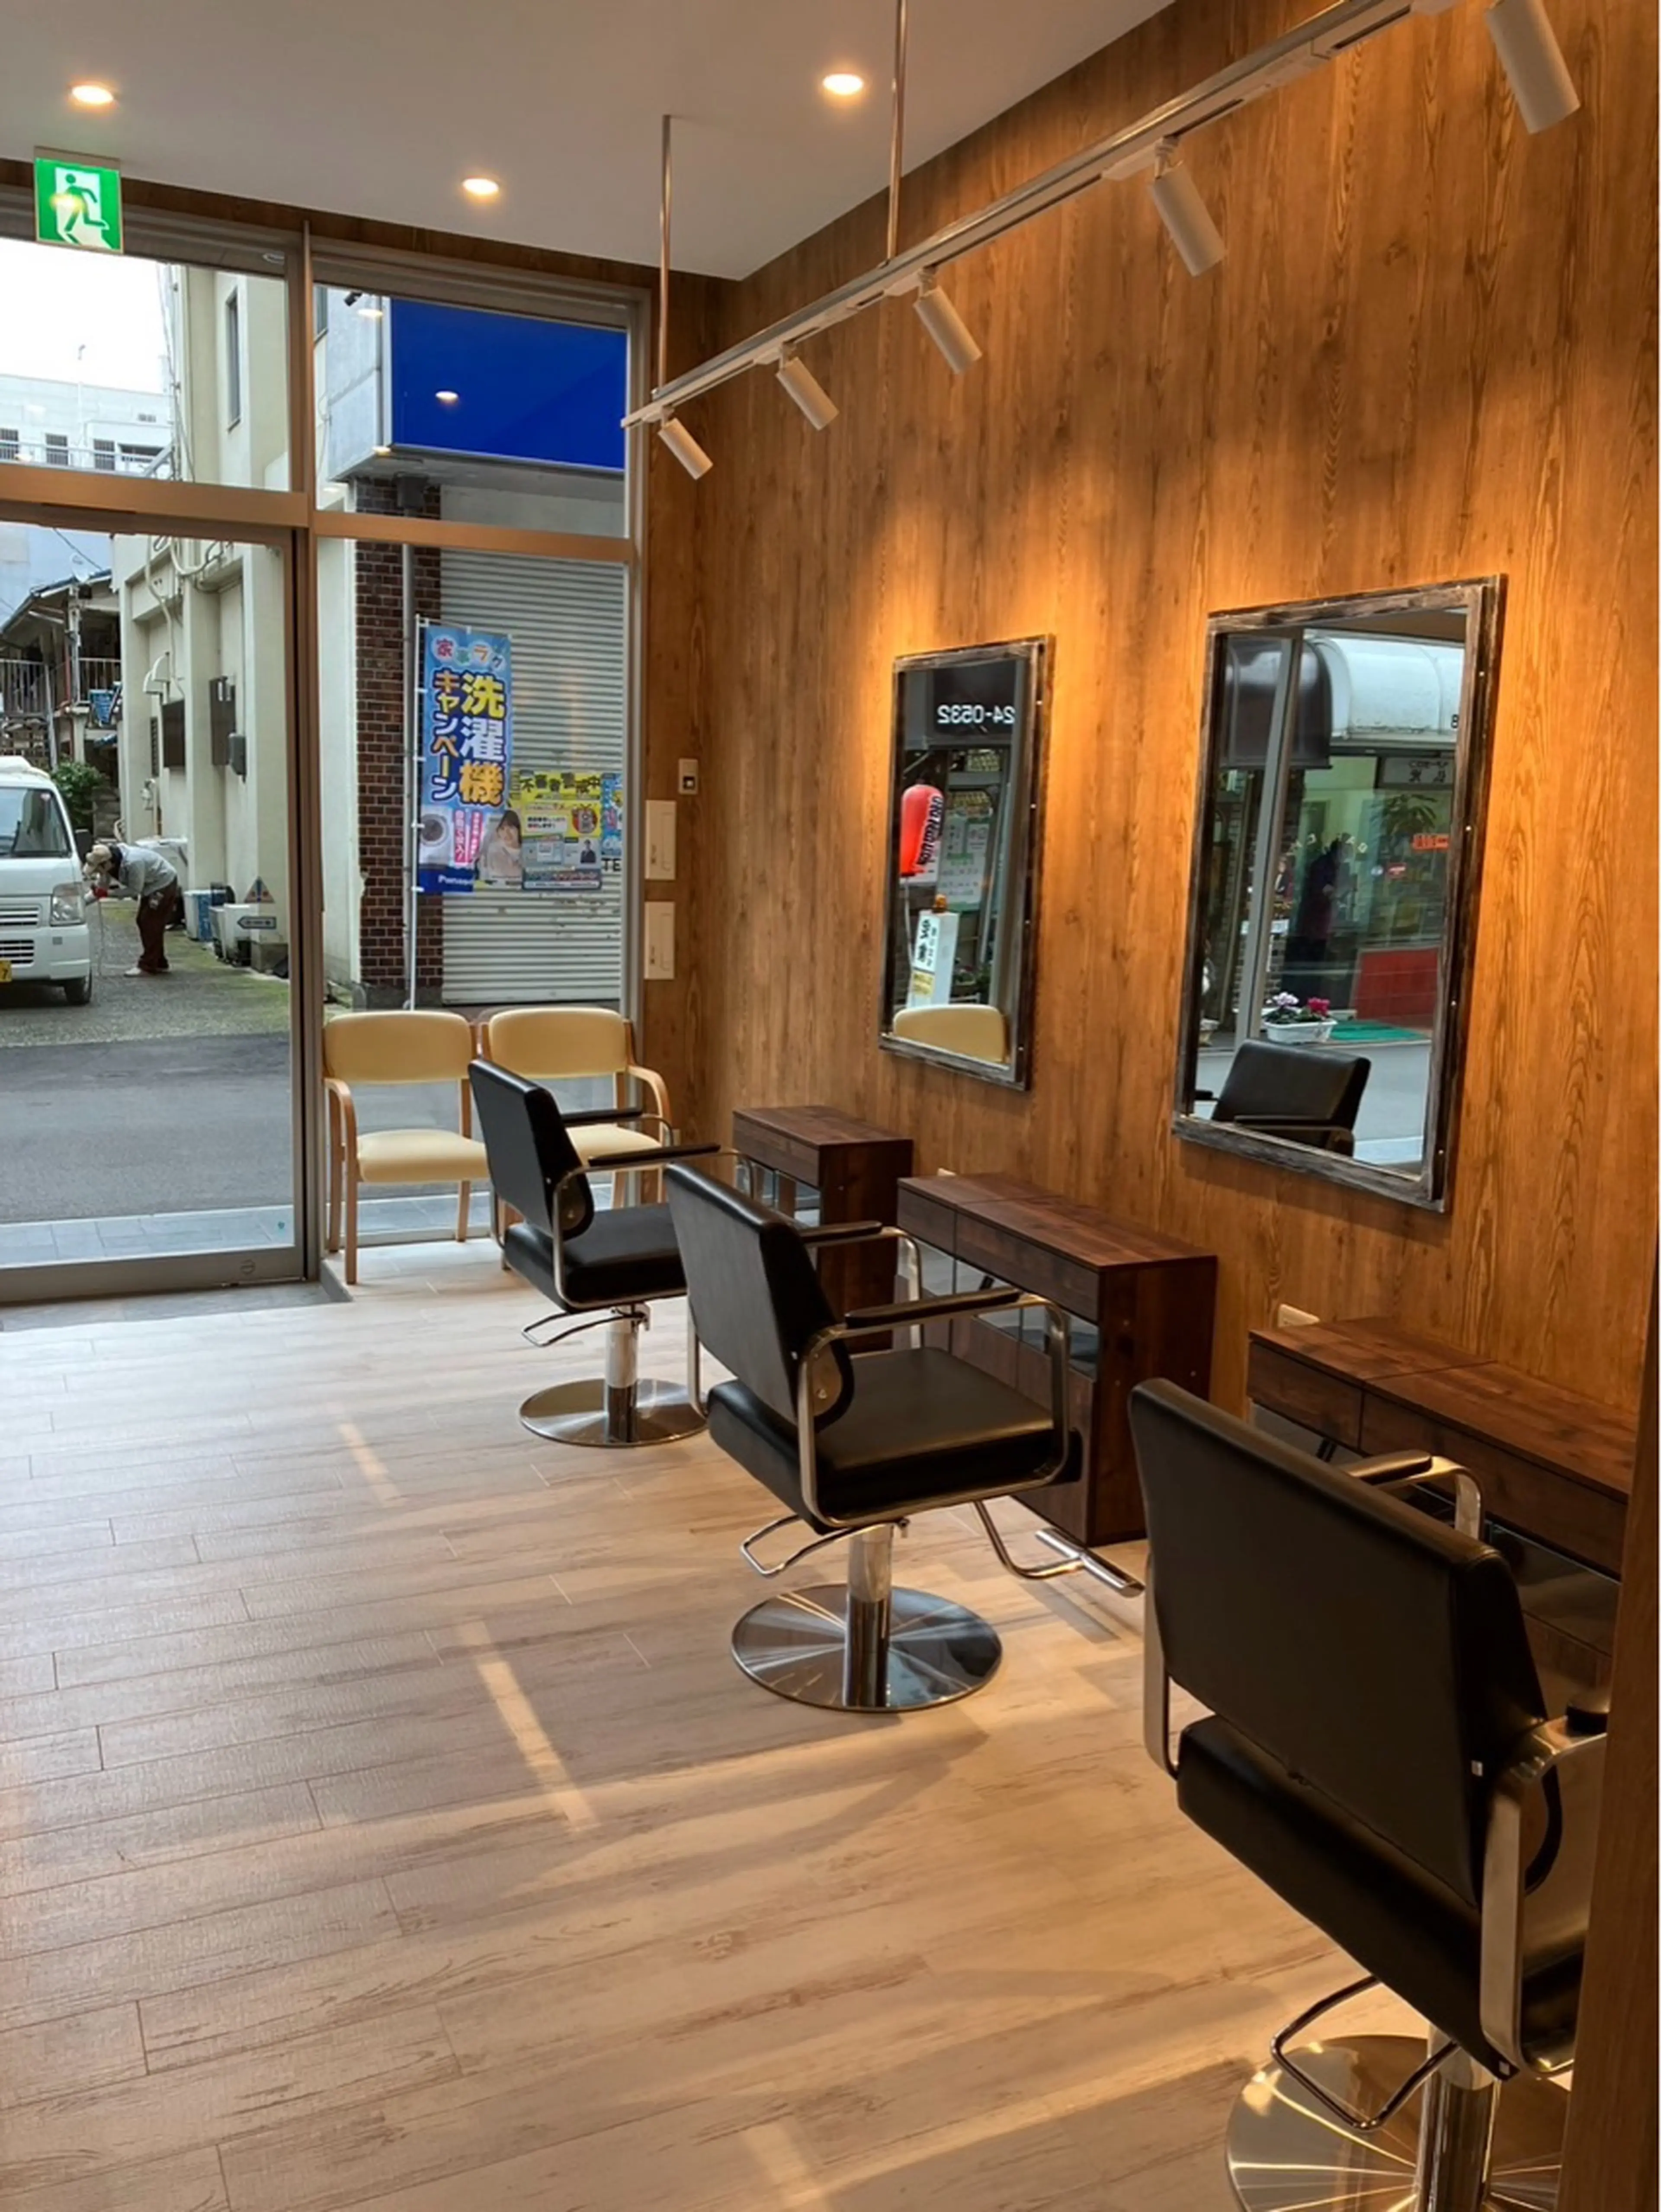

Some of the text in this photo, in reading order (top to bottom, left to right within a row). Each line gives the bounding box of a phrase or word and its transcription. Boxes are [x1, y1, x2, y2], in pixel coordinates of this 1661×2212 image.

[433, 670, 460, 799] キャンペーン
[459, 673, 505, 806] 洗濯機
